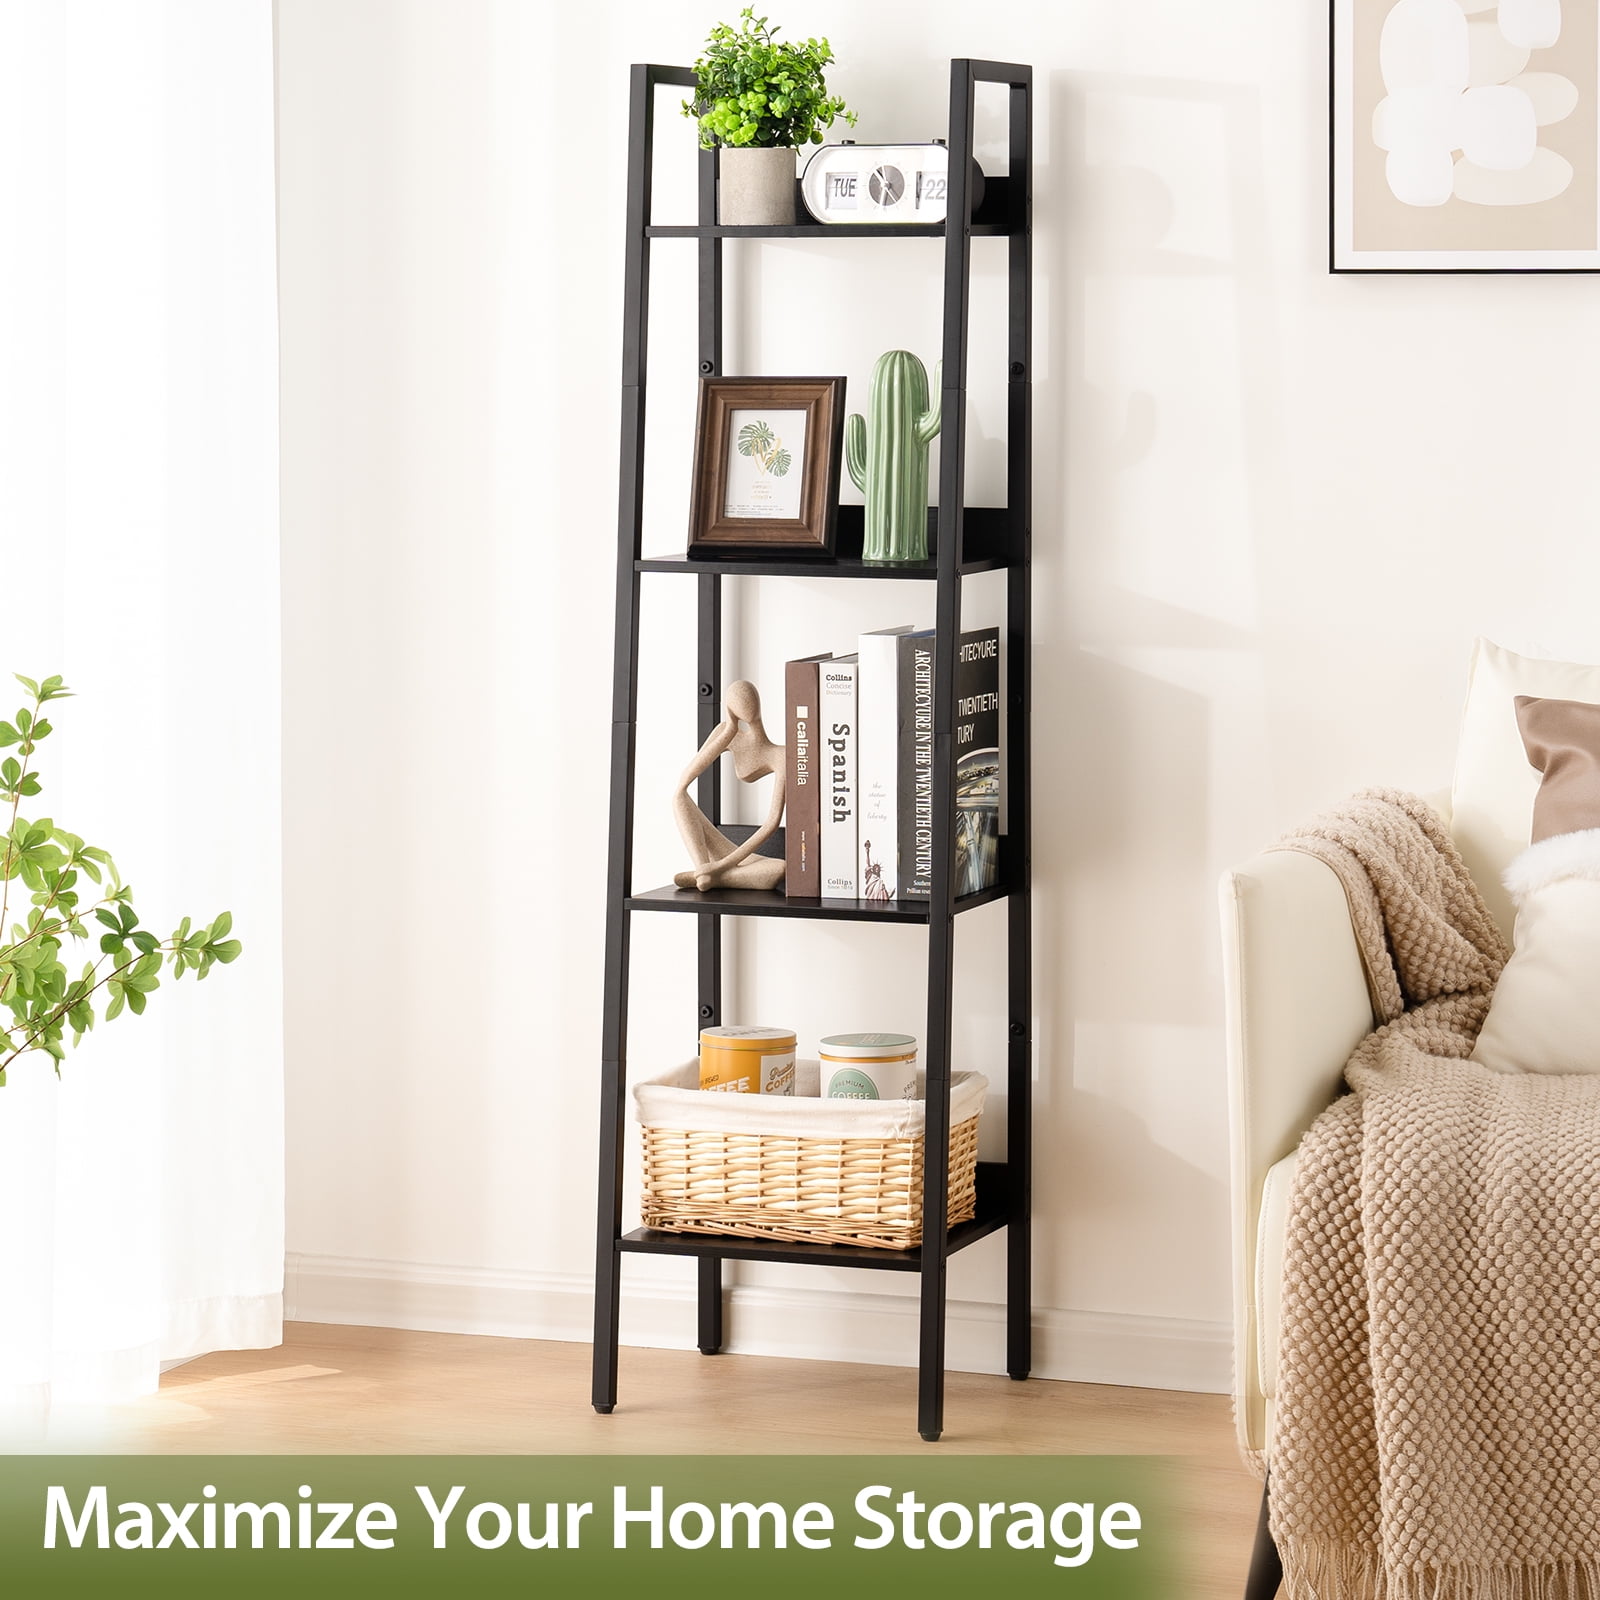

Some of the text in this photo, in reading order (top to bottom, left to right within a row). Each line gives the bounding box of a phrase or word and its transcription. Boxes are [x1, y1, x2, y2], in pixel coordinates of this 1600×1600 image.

[834, 178, 857, 197] TUE
[925, 178, 946, 200] 22
[825, 674, 853, 682] Collins
[915, 648, 931, 730] ARCHITECYURE
[958, 691, 999, 717] TWENTIETH
[915, 731, 931, 743] IN
[915, 745, 931, 765] THE
[828, 723, 852, 823] Spanish
[915, 766, 932, 828] TWENTIETH
[915, 829, 932, 879] CENTURY
